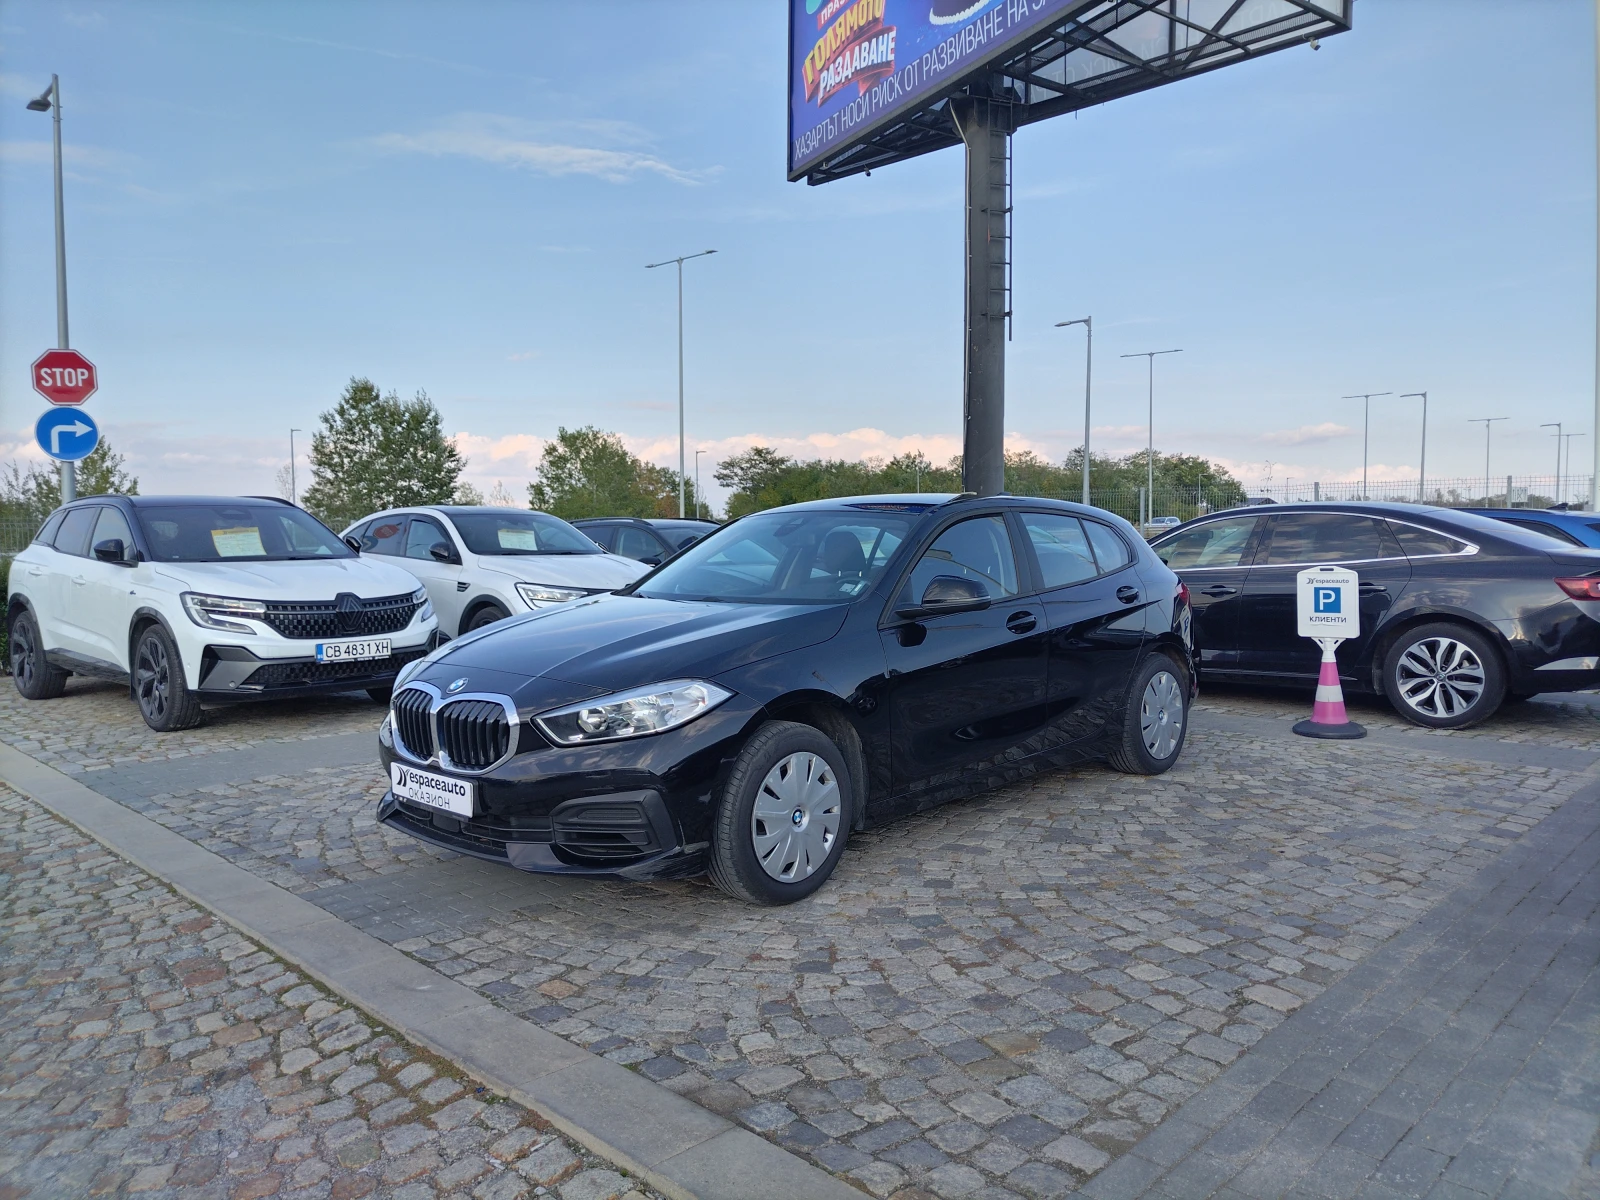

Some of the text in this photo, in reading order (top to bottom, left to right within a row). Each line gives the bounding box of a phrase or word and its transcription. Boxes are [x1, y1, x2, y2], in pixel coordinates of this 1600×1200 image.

[805, 0, 883, 85] ГОЛЯМОТО
[819, 31, 896, 99] РАЗДАВАНЕ
[795, 0, 1029, 160] ХАЗАРТЪТ НОСИ РИСК ОТ РАЗВИВАНЕ НА
[40, 367, 89, 387] STOP
[1319, 590, 1336, 610] P
[325, 645, 341, 658] CB
[344, 643, 371, 657] 4831
[374, 641, 389, 654] XH
[409, 771, 466, 797] espaceauto
[408, 787, 451, 810] ОКАЗИОН
